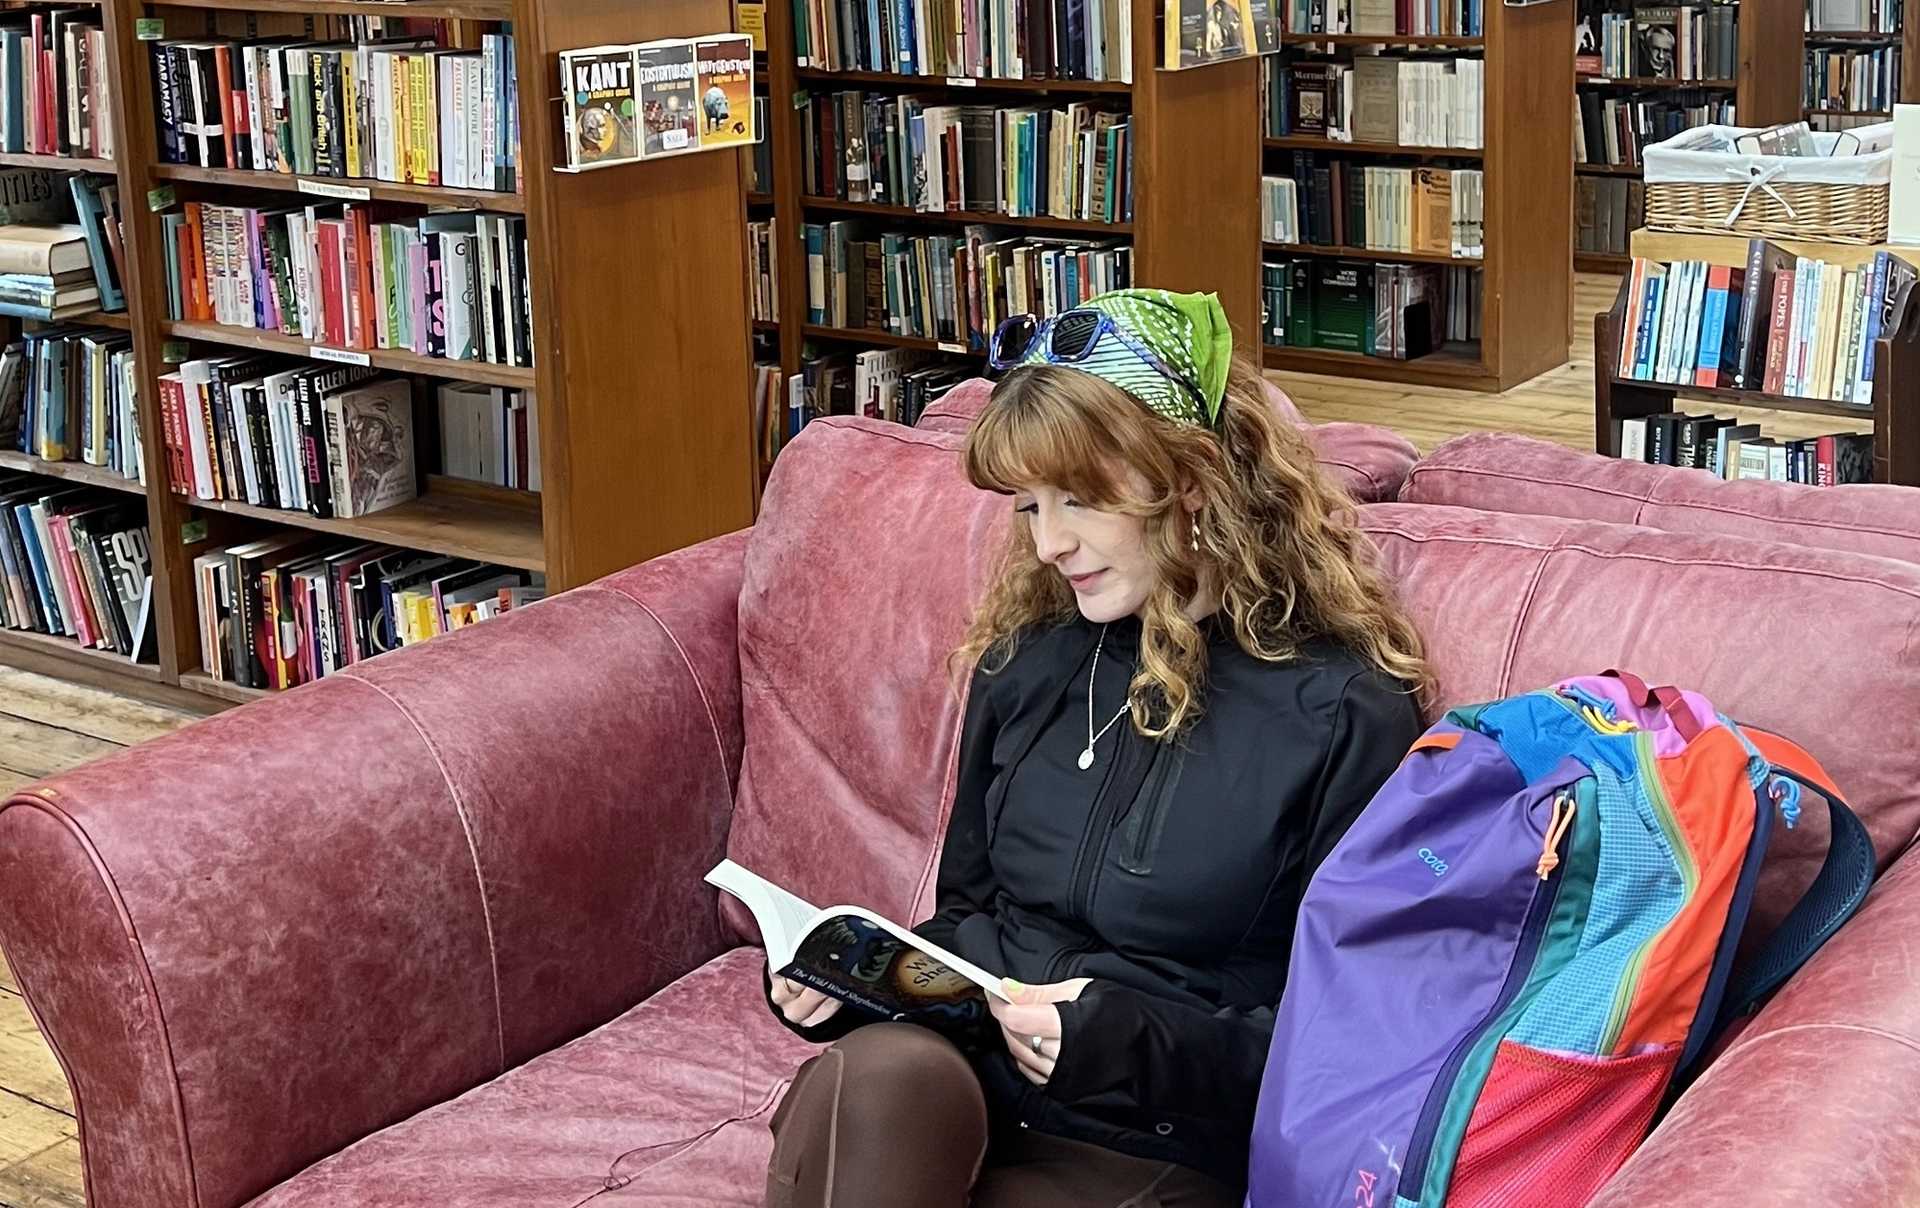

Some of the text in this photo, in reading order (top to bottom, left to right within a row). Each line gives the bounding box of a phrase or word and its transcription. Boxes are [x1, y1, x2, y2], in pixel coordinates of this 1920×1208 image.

[313, 54, 323, 87] Black
[576, 61, 631, 92] KANT
[317, 114, 328, 151] British
[1776, 295, 1788, 329] POPES
[314, 367, 347, 394] ELLEN
[299, 378, 312, 426] ELLEN JONES
[320, 608, 330, 662] TRANS
[792, 968, 808, 979] The
[807, 974, 828, 988] Wild
[827, 982, 848, 995] Wood
